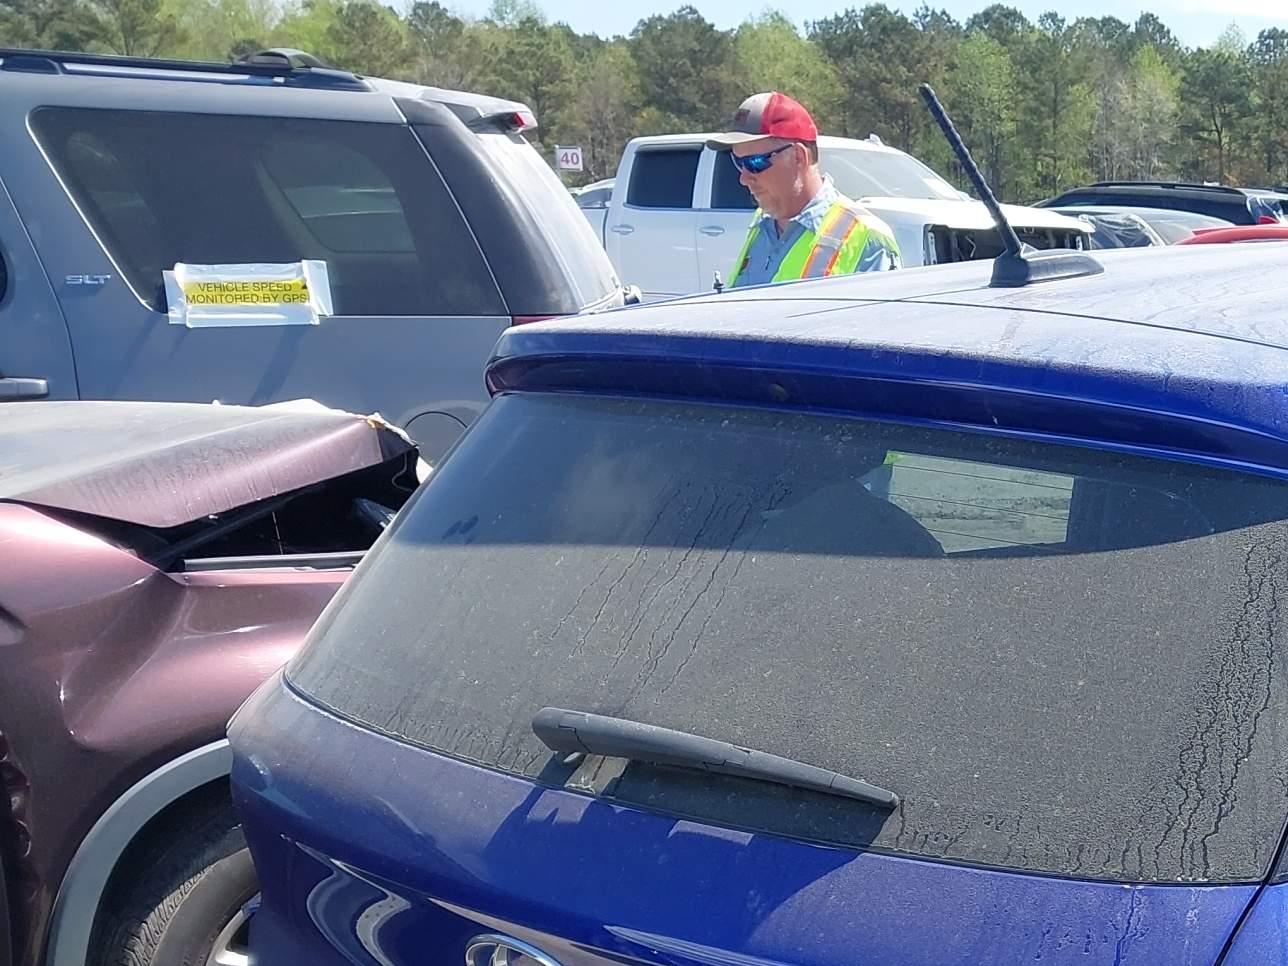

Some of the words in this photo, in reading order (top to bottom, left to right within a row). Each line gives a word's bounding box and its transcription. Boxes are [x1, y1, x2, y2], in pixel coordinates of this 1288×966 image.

[561, 152, 579, 164] 40
[65, 274, 111, 285] SLT
[198, 282, 249, 293] VEHICLE
[252, 281, 292, 292] SPEED
[185, 293, 260, 305] MONITORED
[262, 294, 279, 304] BY
[282, 293, 307, 304] GPS
